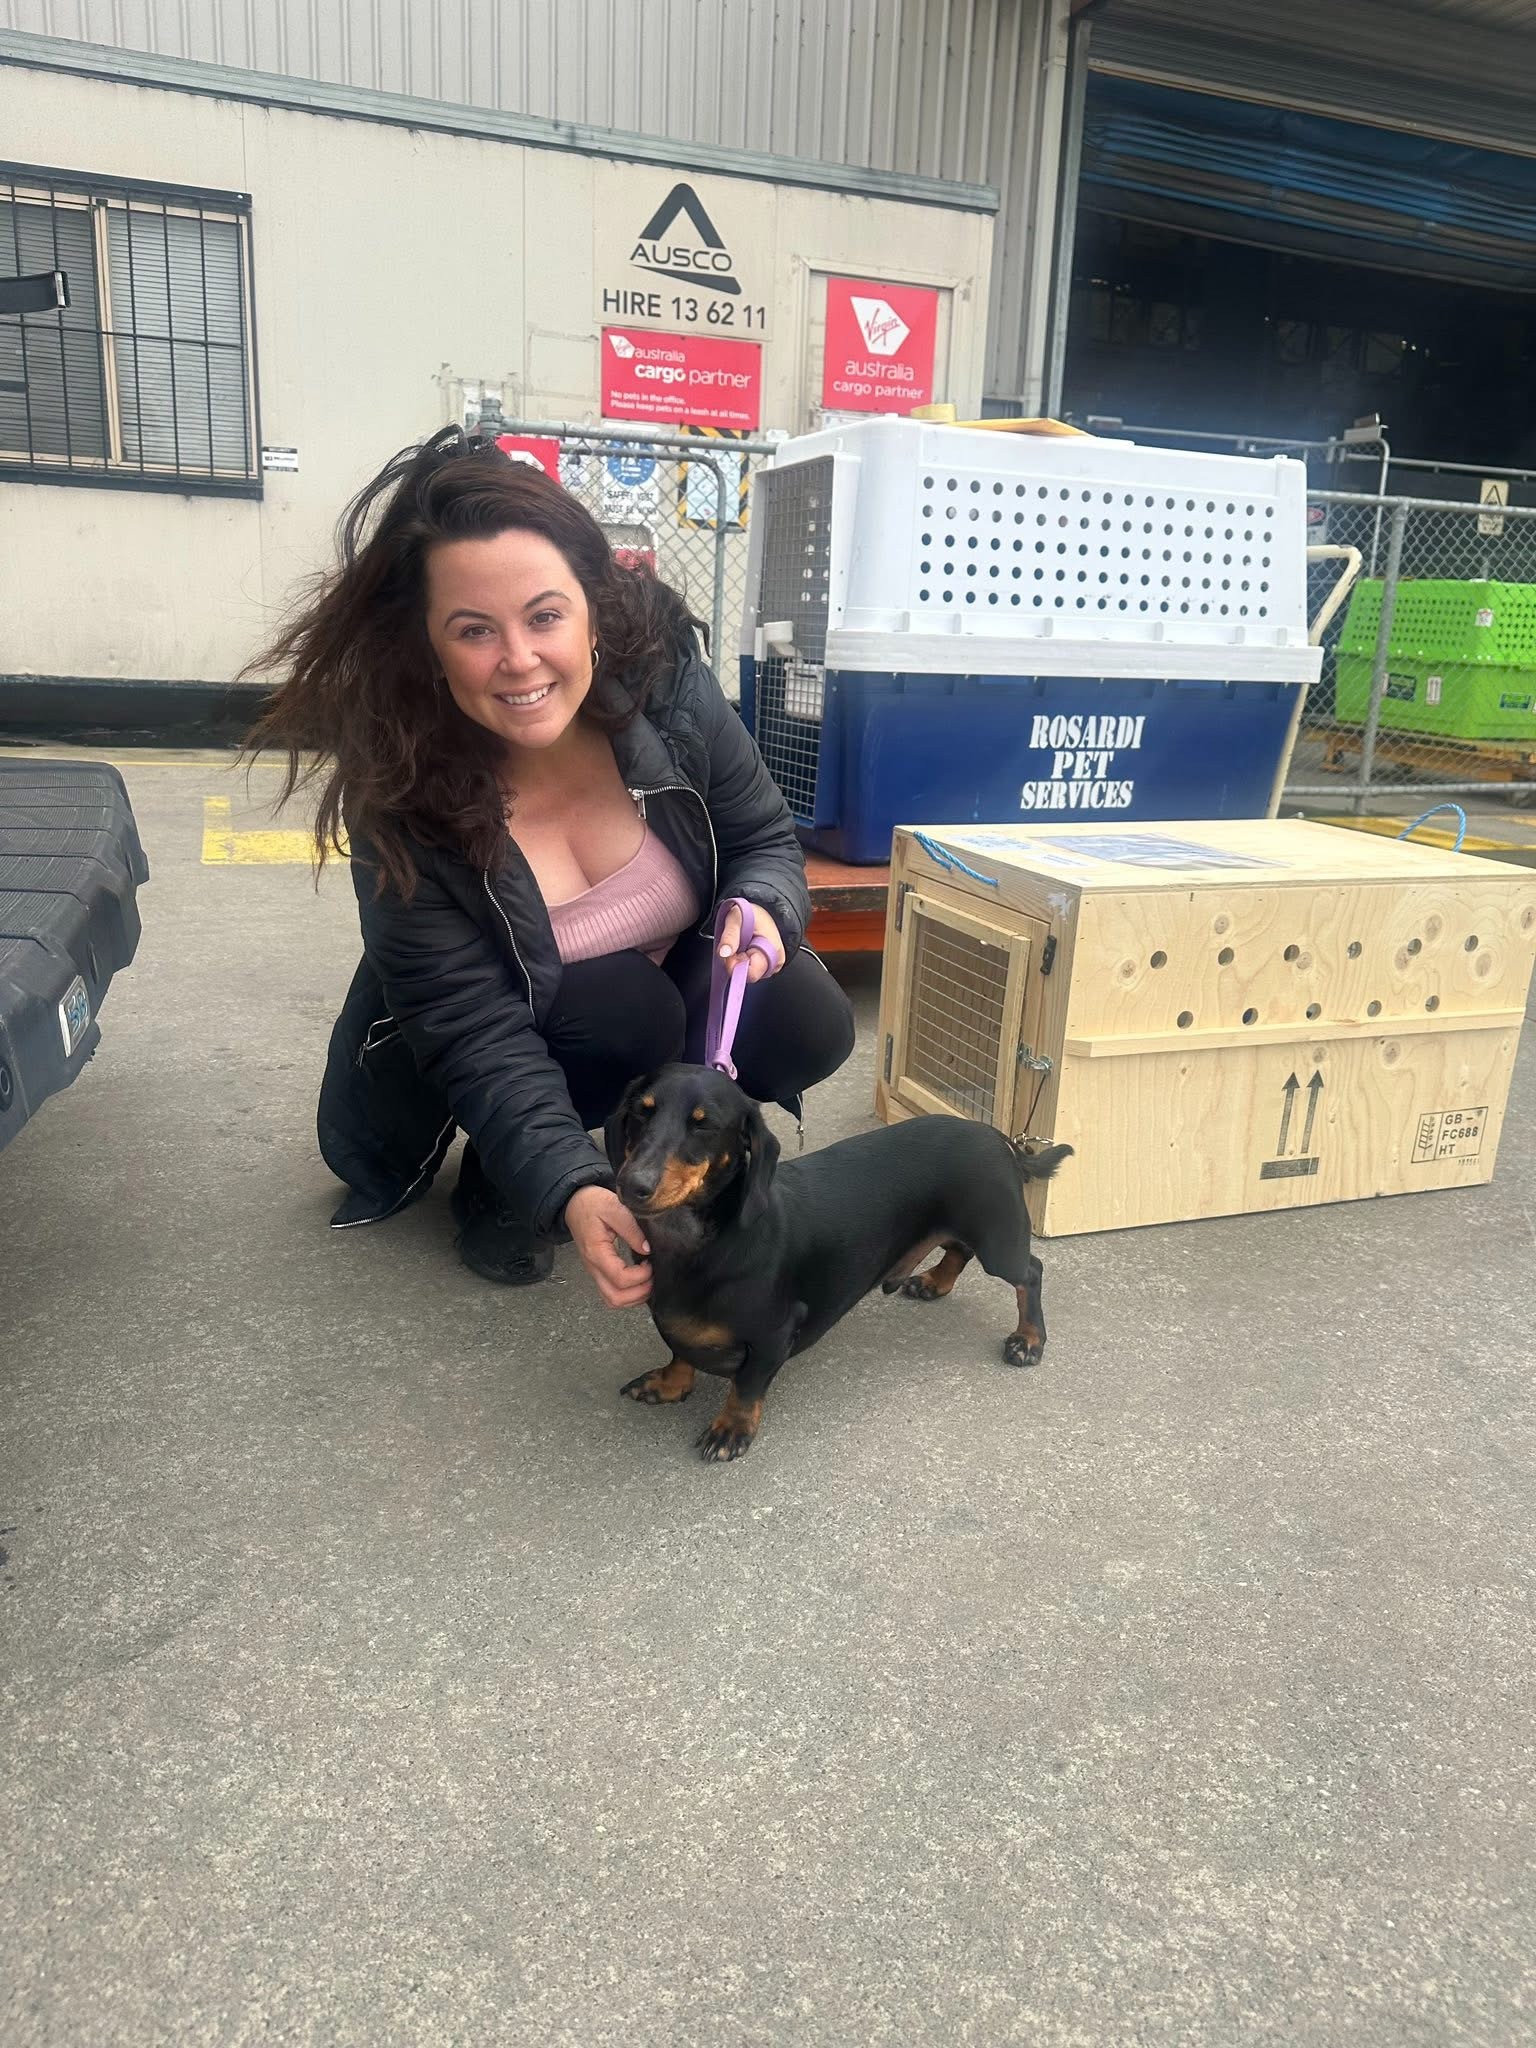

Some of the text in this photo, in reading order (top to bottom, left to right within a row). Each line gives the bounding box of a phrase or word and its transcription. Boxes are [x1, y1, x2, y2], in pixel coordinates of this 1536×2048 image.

[630, 243, 732, 272] AUSCO
[603, 288, 765, 329] HIRE 13 62 11
[634, 348, 685, 363] australia
[634, 364, 752, 388] cargo partner
[845, 360, 914, 381] australia
[611, 390, 622, 398] No
[623, 391, 640, 401] pets
[650, 394, 662, 402] the
[833, 380, 923, 399] cargo partner
[610, 399, 635, 409] Please
[636, 402, 654, 412] keep
[656, 404, 672, 414] pets
[1028, 715, 1146, 749] ROSARDI
[1051, 751, 1115, 779] PET
[1020, 780, 1134, 810] SERVICES
[1442, 1126, 1478, 1141] FC688
[1439, 1144, 1455, 1155] HT
